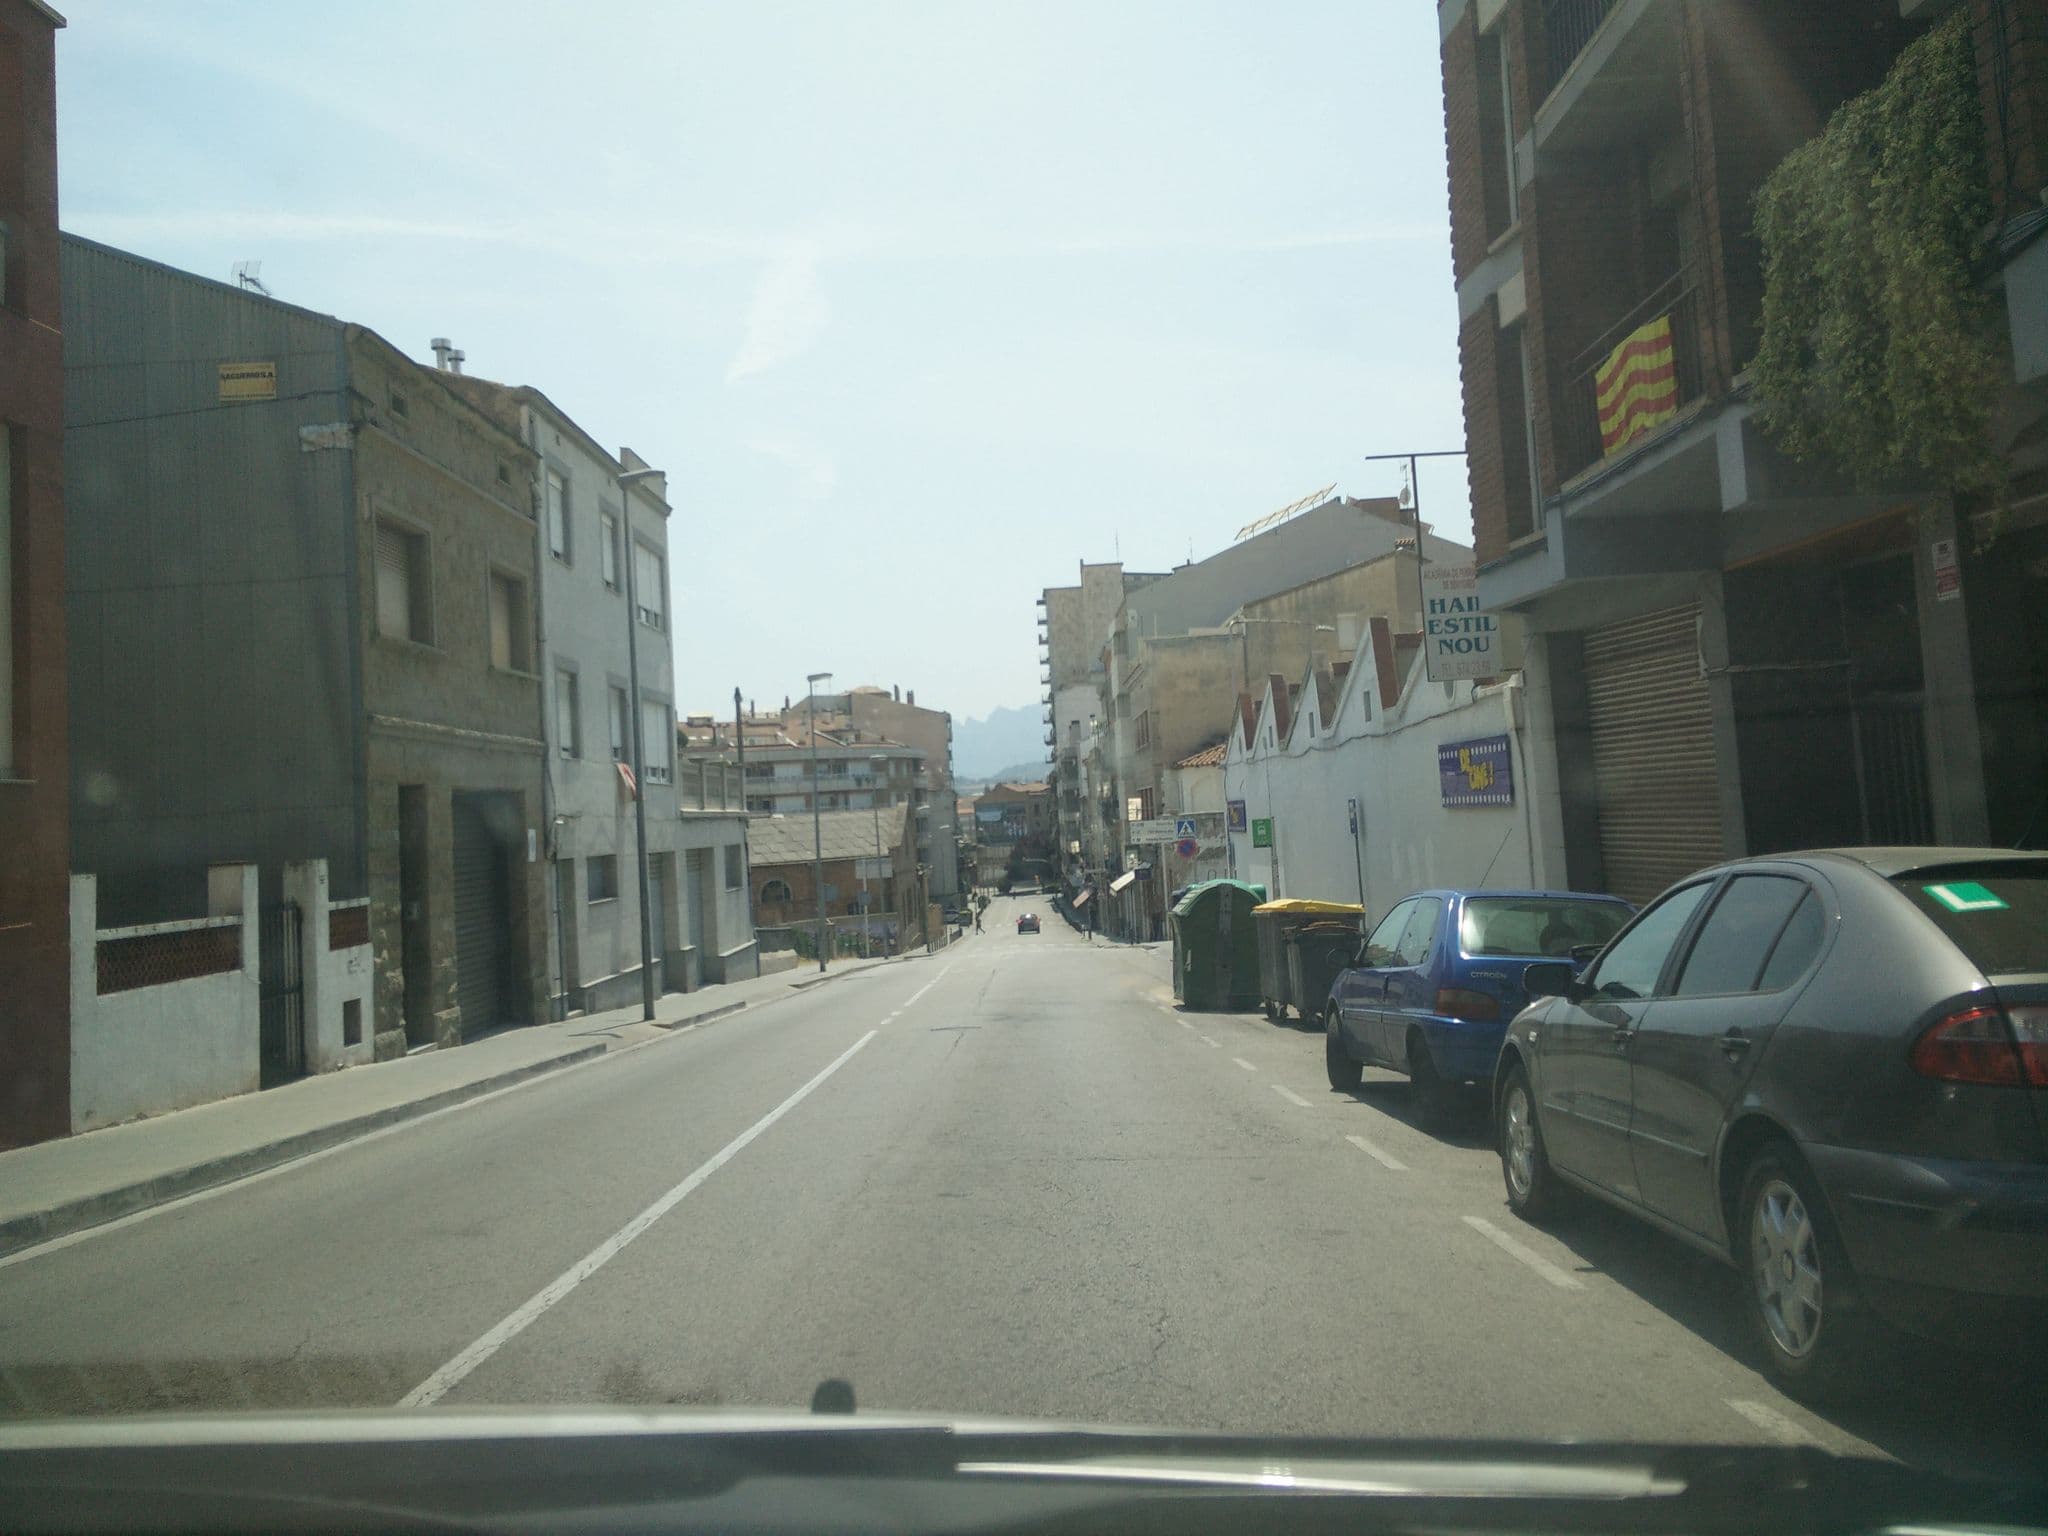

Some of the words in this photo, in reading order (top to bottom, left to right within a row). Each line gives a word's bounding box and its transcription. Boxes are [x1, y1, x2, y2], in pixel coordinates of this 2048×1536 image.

[1430, 596, 1479, 614] HAI
[1428, 616, 1497, 634] ESTIL
[1439, 636, 1489, 654] NOU
[1931, 885, 2003, 910] L
